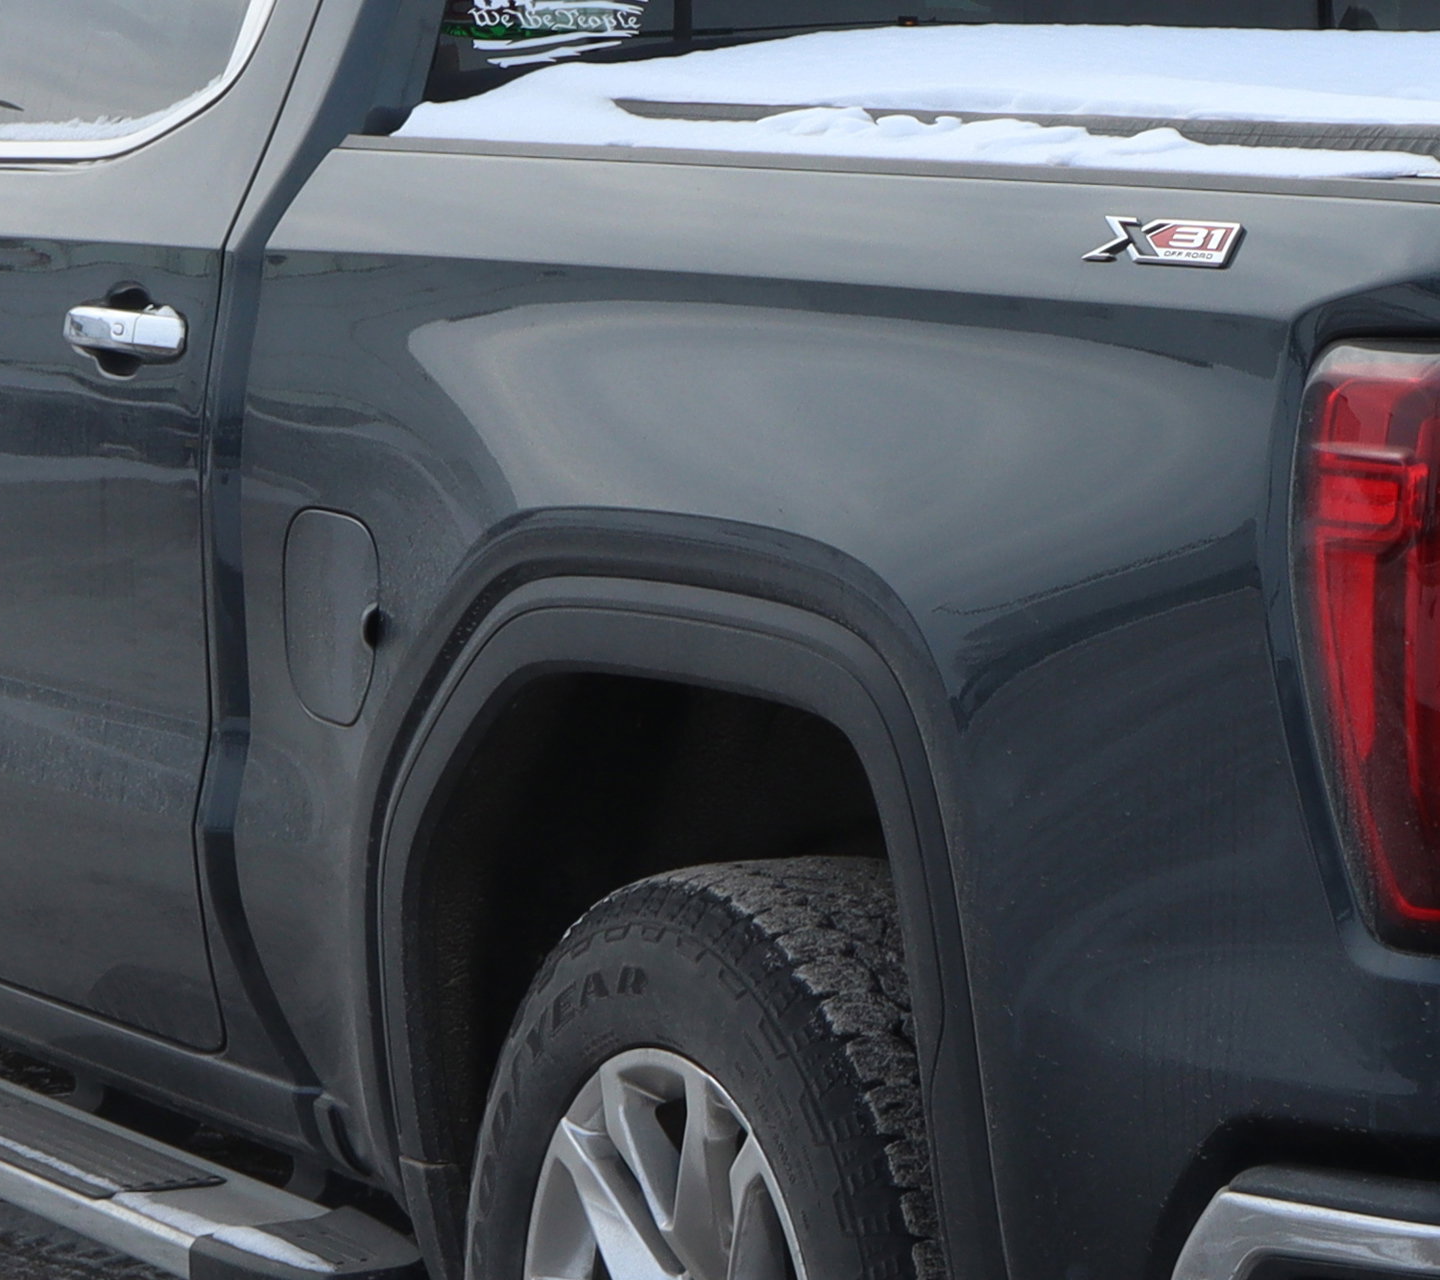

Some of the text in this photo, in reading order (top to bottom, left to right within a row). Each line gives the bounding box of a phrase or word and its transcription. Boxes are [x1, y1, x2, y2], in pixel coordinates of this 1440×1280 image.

[467, 8, 512, 27] We
[552, 9, 642, 32] People
[1164, 250, 1214, 260] OFF ROAD
